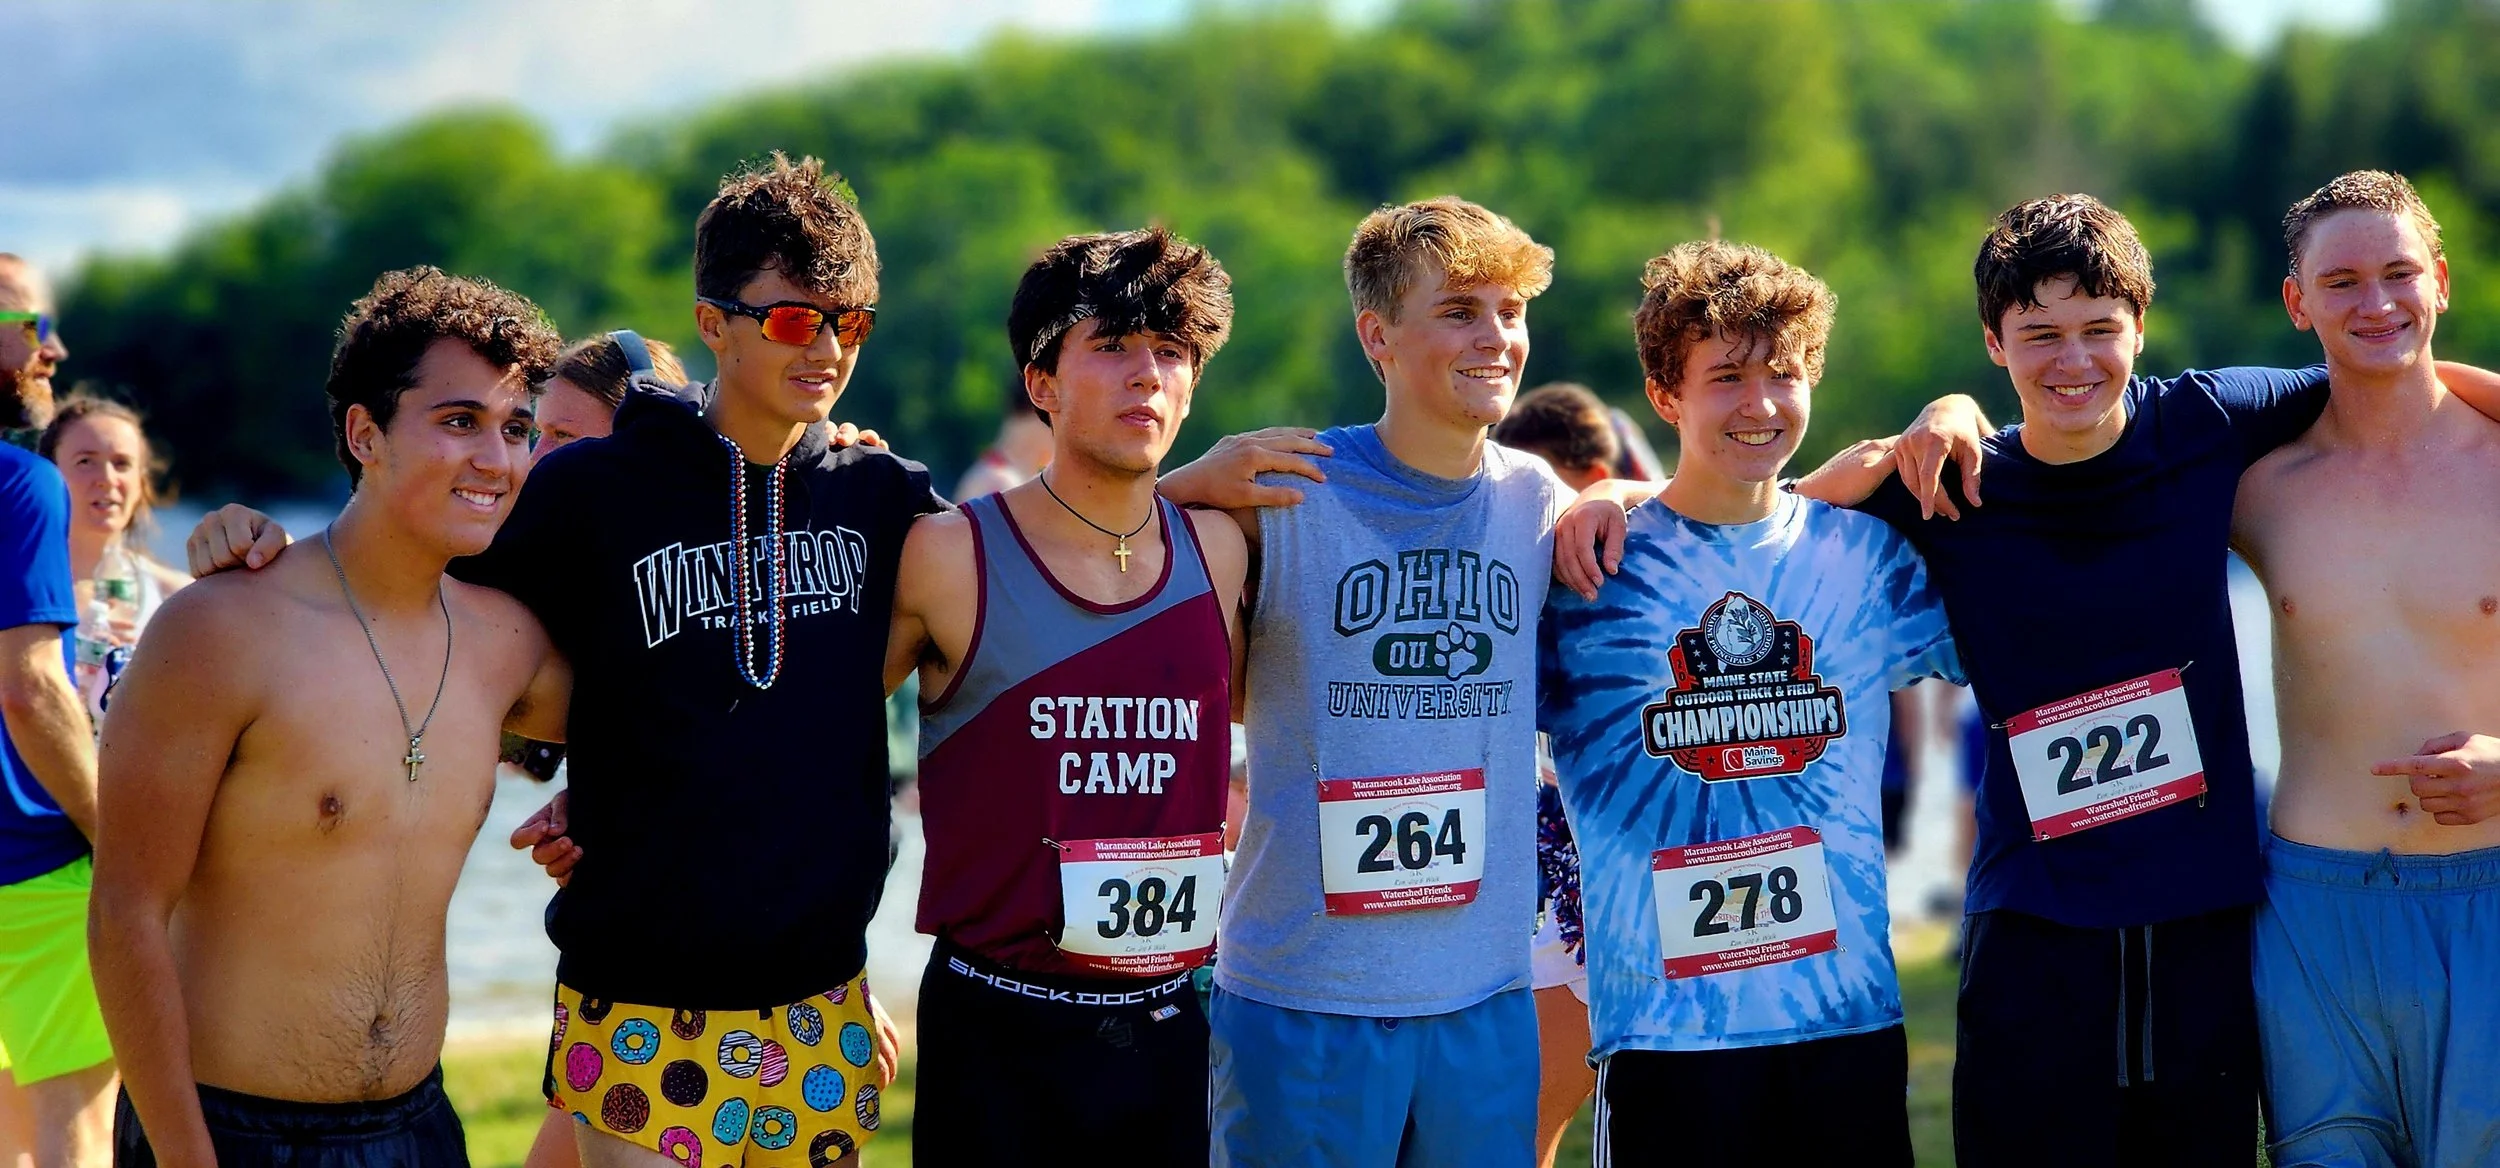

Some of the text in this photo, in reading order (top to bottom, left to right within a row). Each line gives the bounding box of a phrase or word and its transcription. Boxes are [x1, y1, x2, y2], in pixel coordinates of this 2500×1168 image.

[1334, 549, 1519, 637] OHIO
[701, 610, 768, 630] TRAK
[792, 597, 841, 618] FIELD
[1389, 641, 1427, 668] OU
[1703, 670, 1788, 689] MAINE STATE
[1328, 680, 1513, 719] UNIVERSITY
[1675, 683, 1815, 707] OUTDOOR TRACK & FIELD
[2035, 679, 2150, 718] Maranacook Lake Association
[2037, 688, 2152, 726] www.maranacooklakeme.org
[1030, 696, 1199, 741] STATION
[1652, 695, 1840, 749] CHAMPIONSHIPS
[1744, 746, 1776, 757] Maine
[1745, 755, 1784, 767] Savings
[2047, 714, 2170, 795] 222
[1059, 752, 1176, 794] CAMP
[1352, 773, 1462, 790] Maranacook Lake Association
[1353, 782, 1462, 799] www.maranacooklakeme.org
[2086, 796, 2128, 815] Watershed
[2129, 788, 2159, 803] Friends
[2070, 792, 2177, 829] www.watershedfriends.com
[1095, 838, 1201, 851] Maranacook Lake Association
[1356, 808, 1466, 873] 264
[1684, 831, 1792, 857] Maranacook Lake Association
[1685, 841, 1793, 866] www.maranacooklakeme.org
[1097, 848, 1201, 860] www.maranacooklakeme.org
[1363, 892, 1466, 910] www.watershedfriends.com
[1381, 885, 1452, 900] Watershed Friends
[1689, 866, 1803, 937] 278
[1097, 875, 1196, 939] 384
[1111, 954, 1175, 965] Watershed Friends
[1701, 947, 1807, 972] www.watershedfriends.com
[1718, 941, 1790, 960] Watershed Friends
[1089, 961, 1185, 973] www.watershedfriends.com
